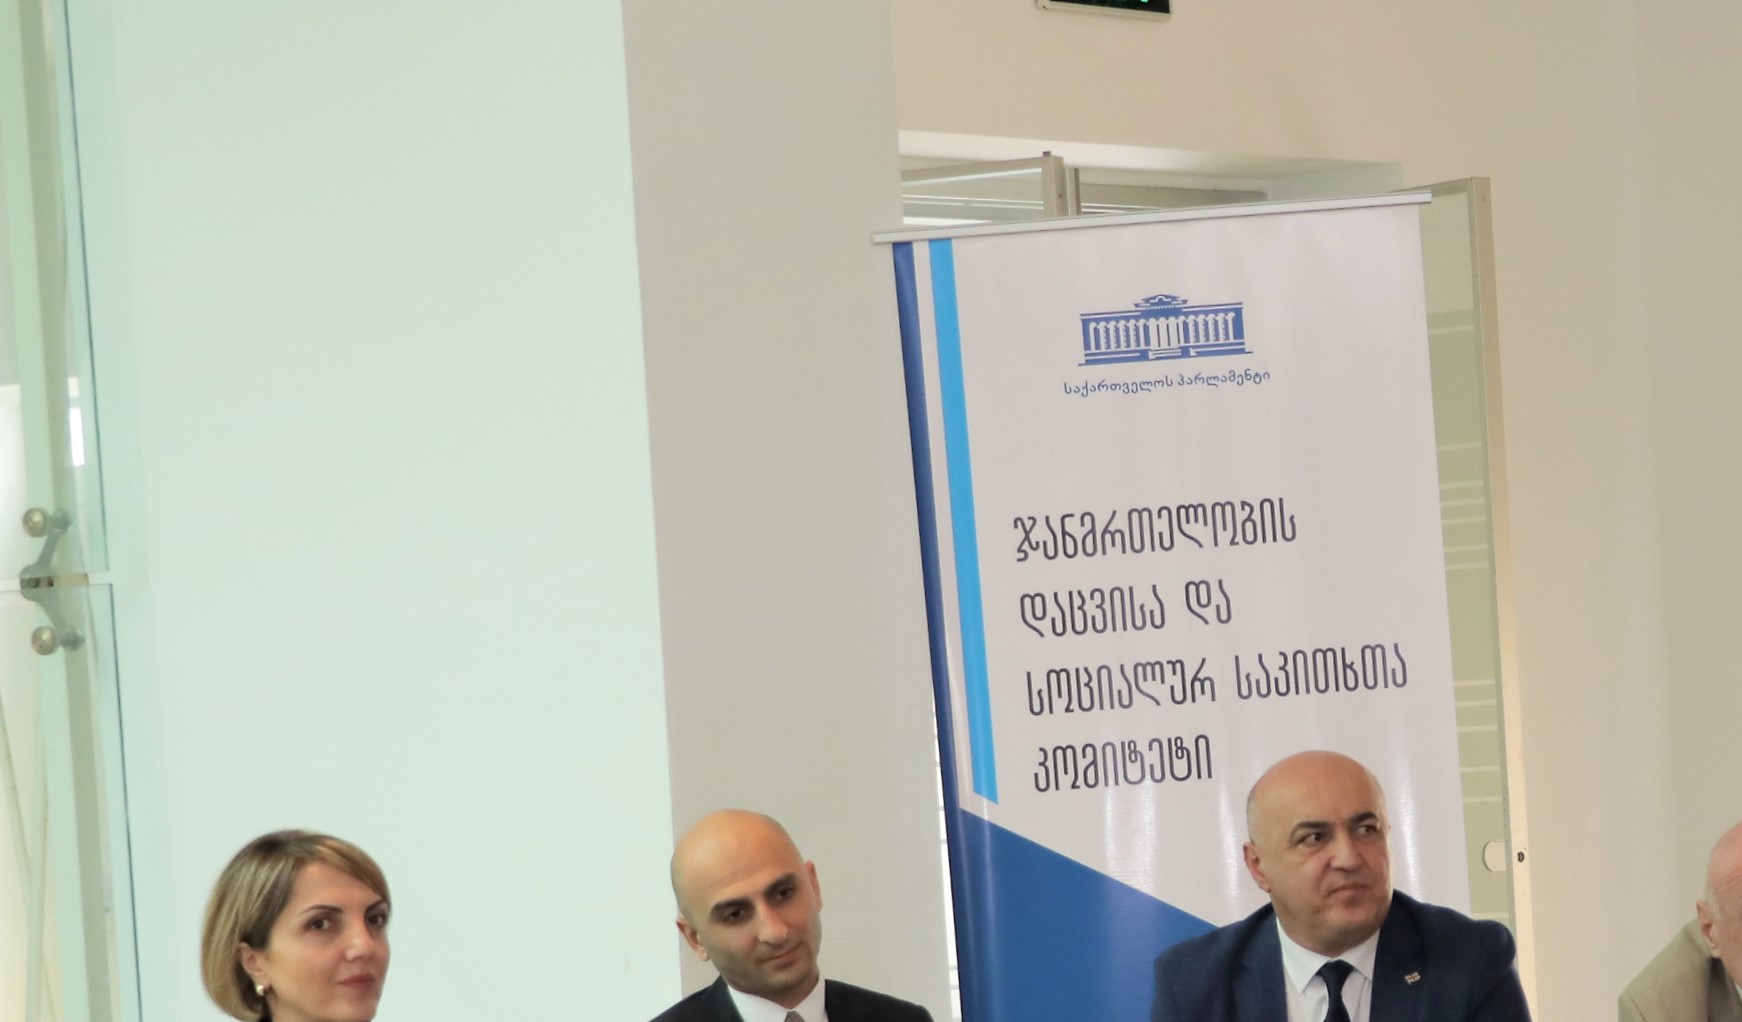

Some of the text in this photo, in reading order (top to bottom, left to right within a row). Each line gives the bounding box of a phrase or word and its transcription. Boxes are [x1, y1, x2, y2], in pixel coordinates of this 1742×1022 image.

[1064, 368, 1270, 397] საქართველოს პარლამენტი
[1012, 496, 1298, 562] ჯანმრთელობის
[1019, 578, 1232, 638] დაცვისა და
[1026, 642, 1408, 716] სოციალურ საკითხთა
[1033, 734, 1213, 793] კომიტეტი
